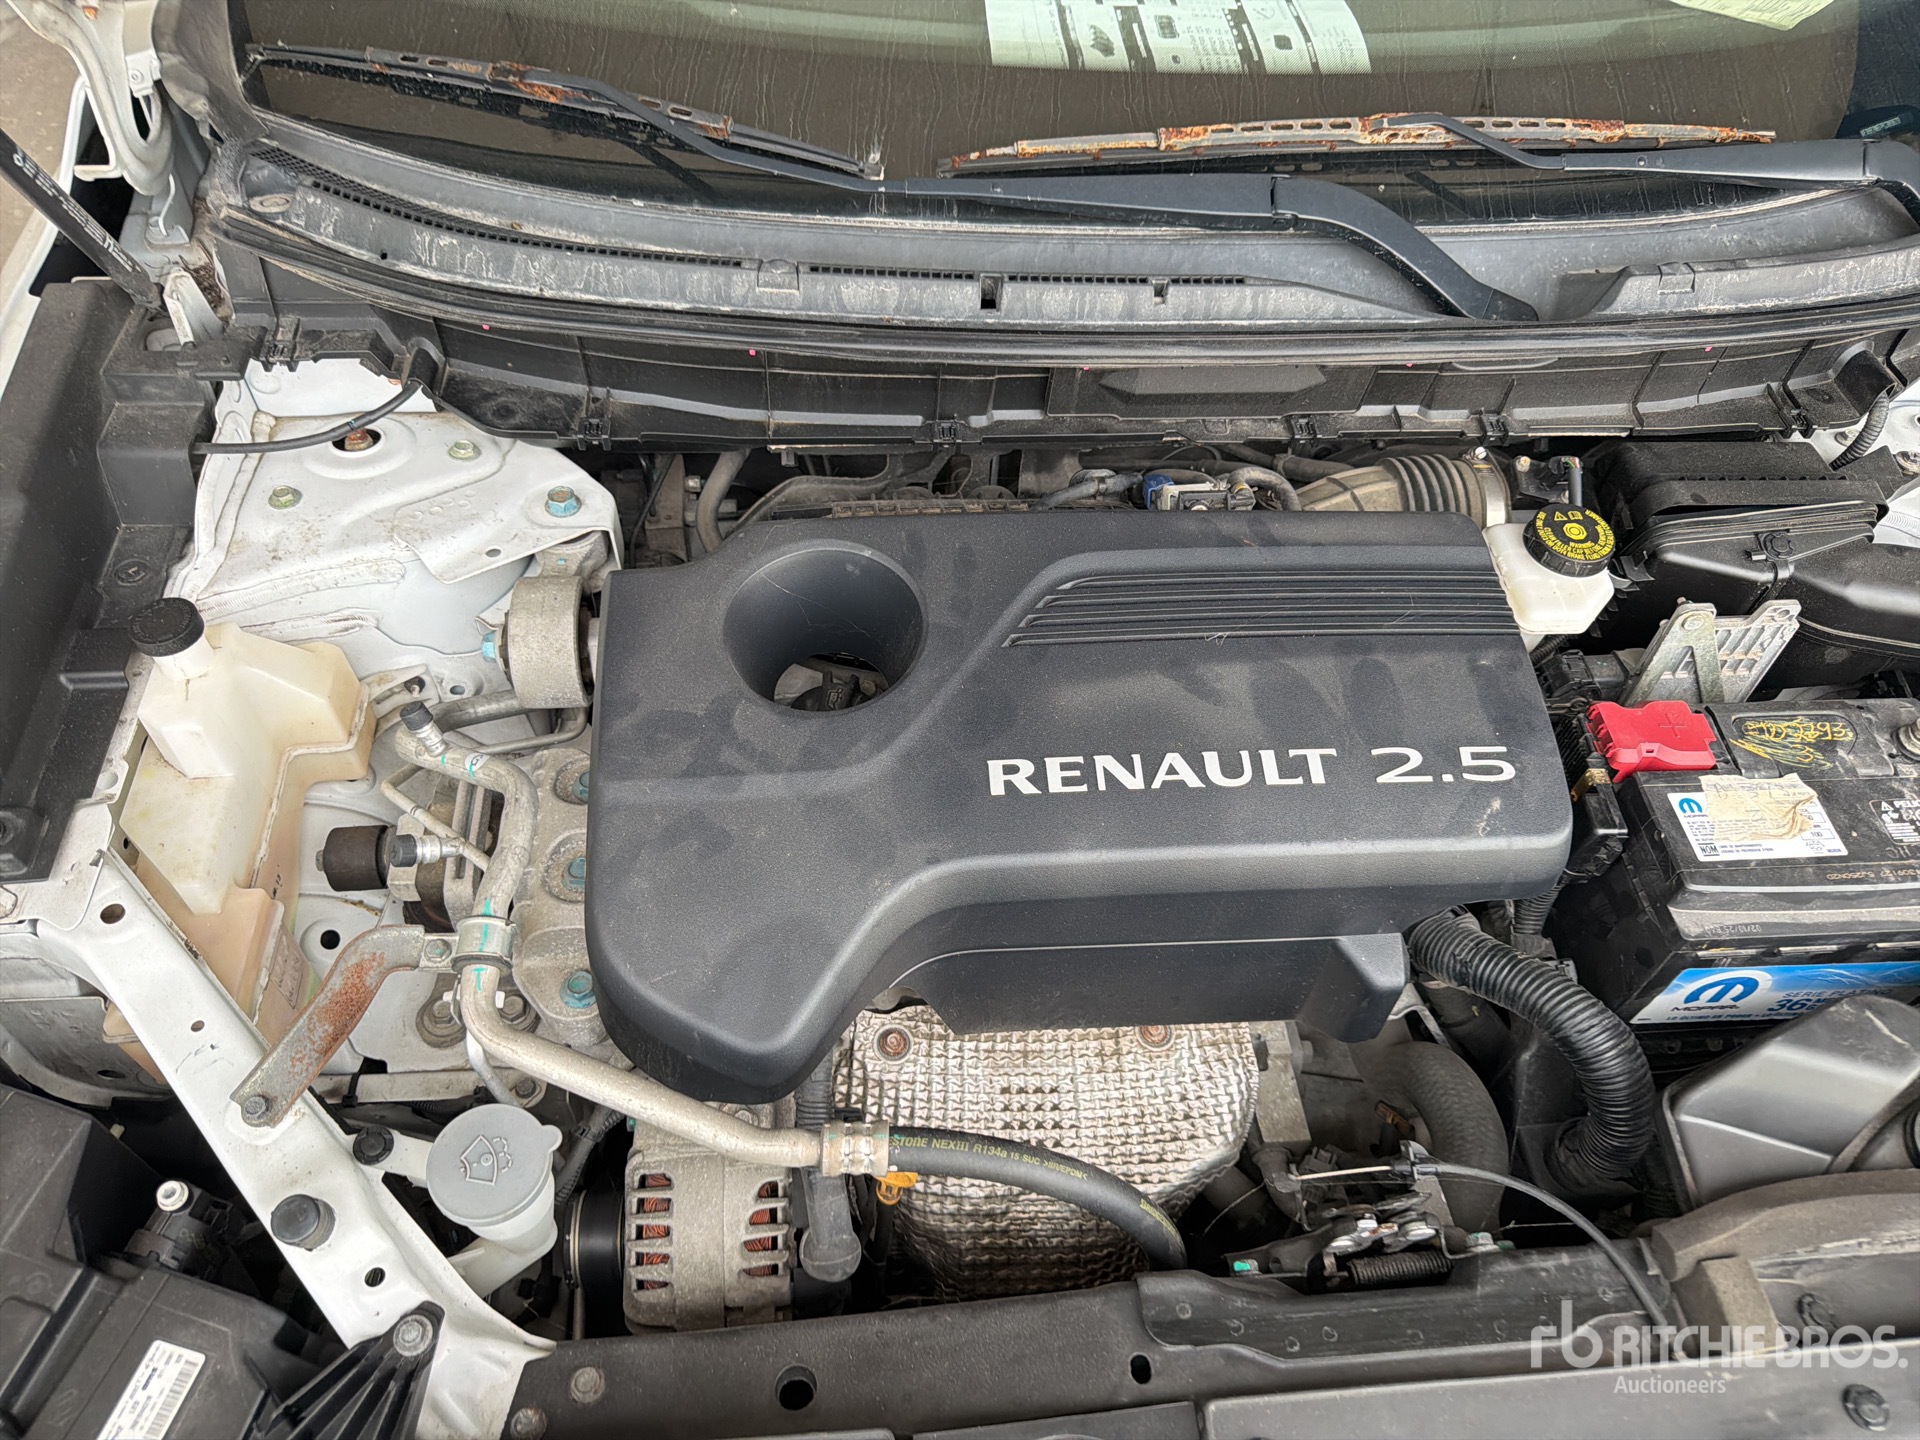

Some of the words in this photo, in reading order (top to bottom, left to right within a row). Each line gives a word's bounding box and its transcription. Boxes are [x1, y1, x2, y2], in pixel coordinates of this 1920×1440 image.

[1572, 547, 1583, 555] CAP
[987, 748, 1337, 796] RENAULT
[1371, 745, 1516, 783] 2.5
[1699, 845, 1719, 854] NOM
[1782, 990, 1828, 998] SERIE
[1767, 999, 1812, 1012] 36
[973, 1144, 1007, 1158] R134a
[1010, 1151, 1021, 1160] 15
[1022, 1154, 1041, 1165] SUC
